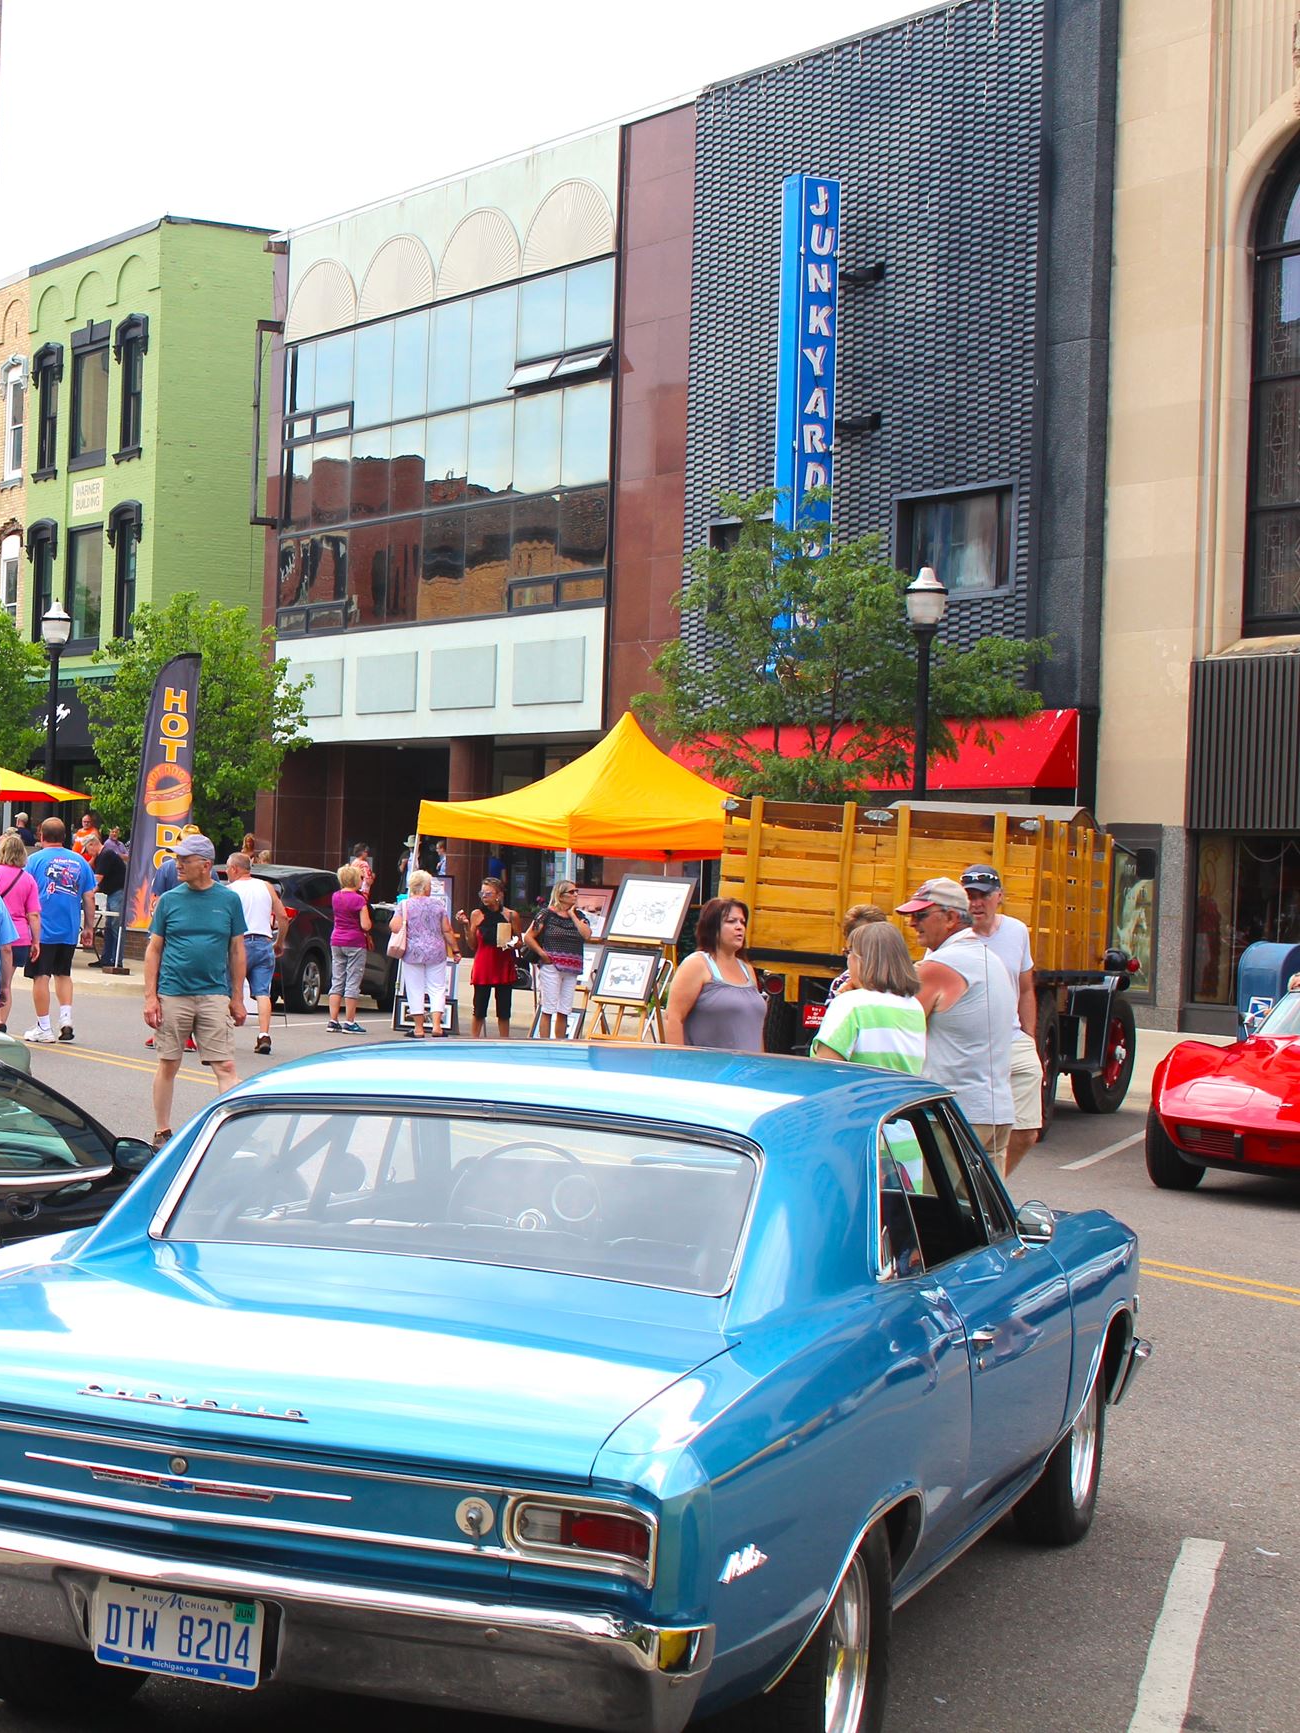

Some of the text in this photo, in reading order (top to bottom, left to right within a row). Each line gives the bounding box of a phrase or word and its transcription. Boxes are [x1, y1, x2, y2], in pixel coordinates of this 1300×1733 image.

[802, 186, 835, 492] JUNKYARD
[159, 686, 190, 762] HOT
[142, 1593, 219, 1613] PURE MICHIGAN
[236, 1610, 254, 1620] JUN
[105, 1603, 250, 1667] DTW 8204
[151, 1660, 198, 1676] michigan.org
